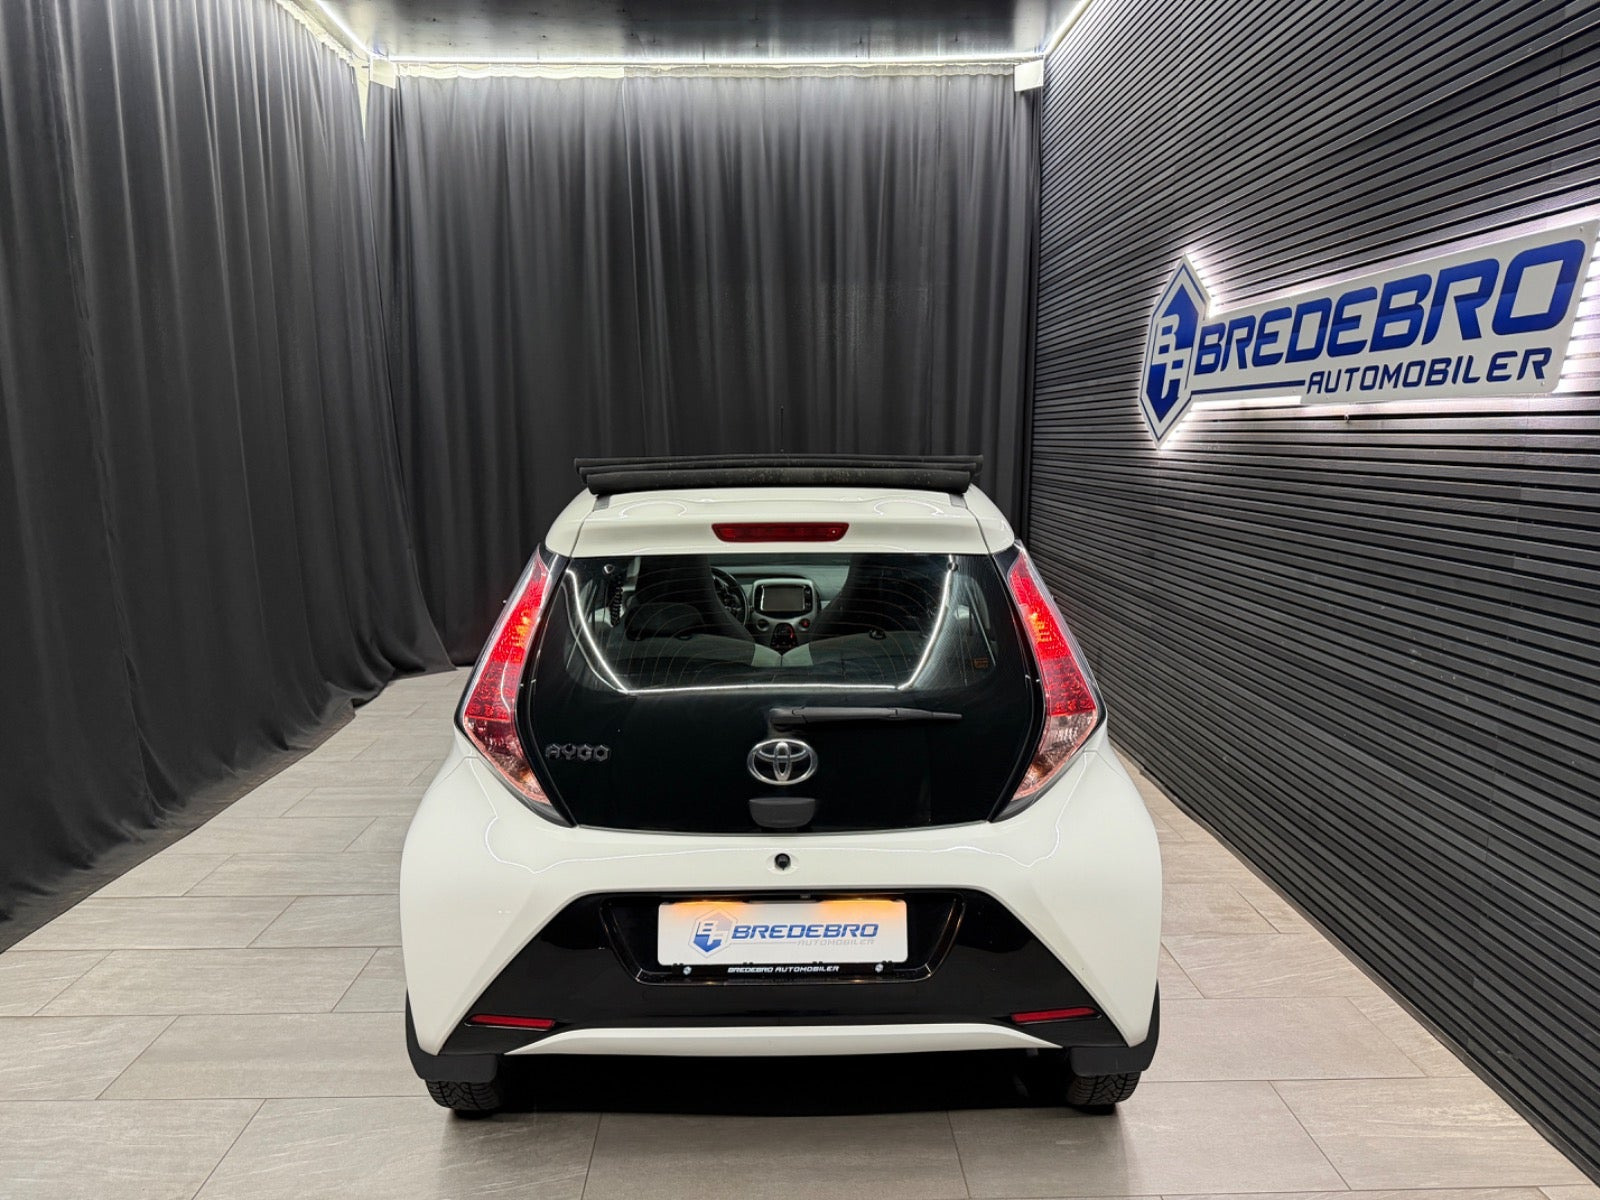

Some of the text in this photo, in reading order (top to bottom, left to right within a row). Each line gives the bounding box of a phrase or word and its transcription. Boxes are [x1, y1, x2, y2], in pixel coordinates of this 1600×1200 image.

[1193, 238, 1587, 376] BREDEBRO
[1306, 347, 1553, 395] AUTOMOBILER
[545, 743, 609, 761] AYGO
[731, 923, 879, 940] BREDEBRO
[796, 938, 877, 947] AUTOMOBILER
[727, 965, 840, 974] BREDEBRO AUTOMOBILER
